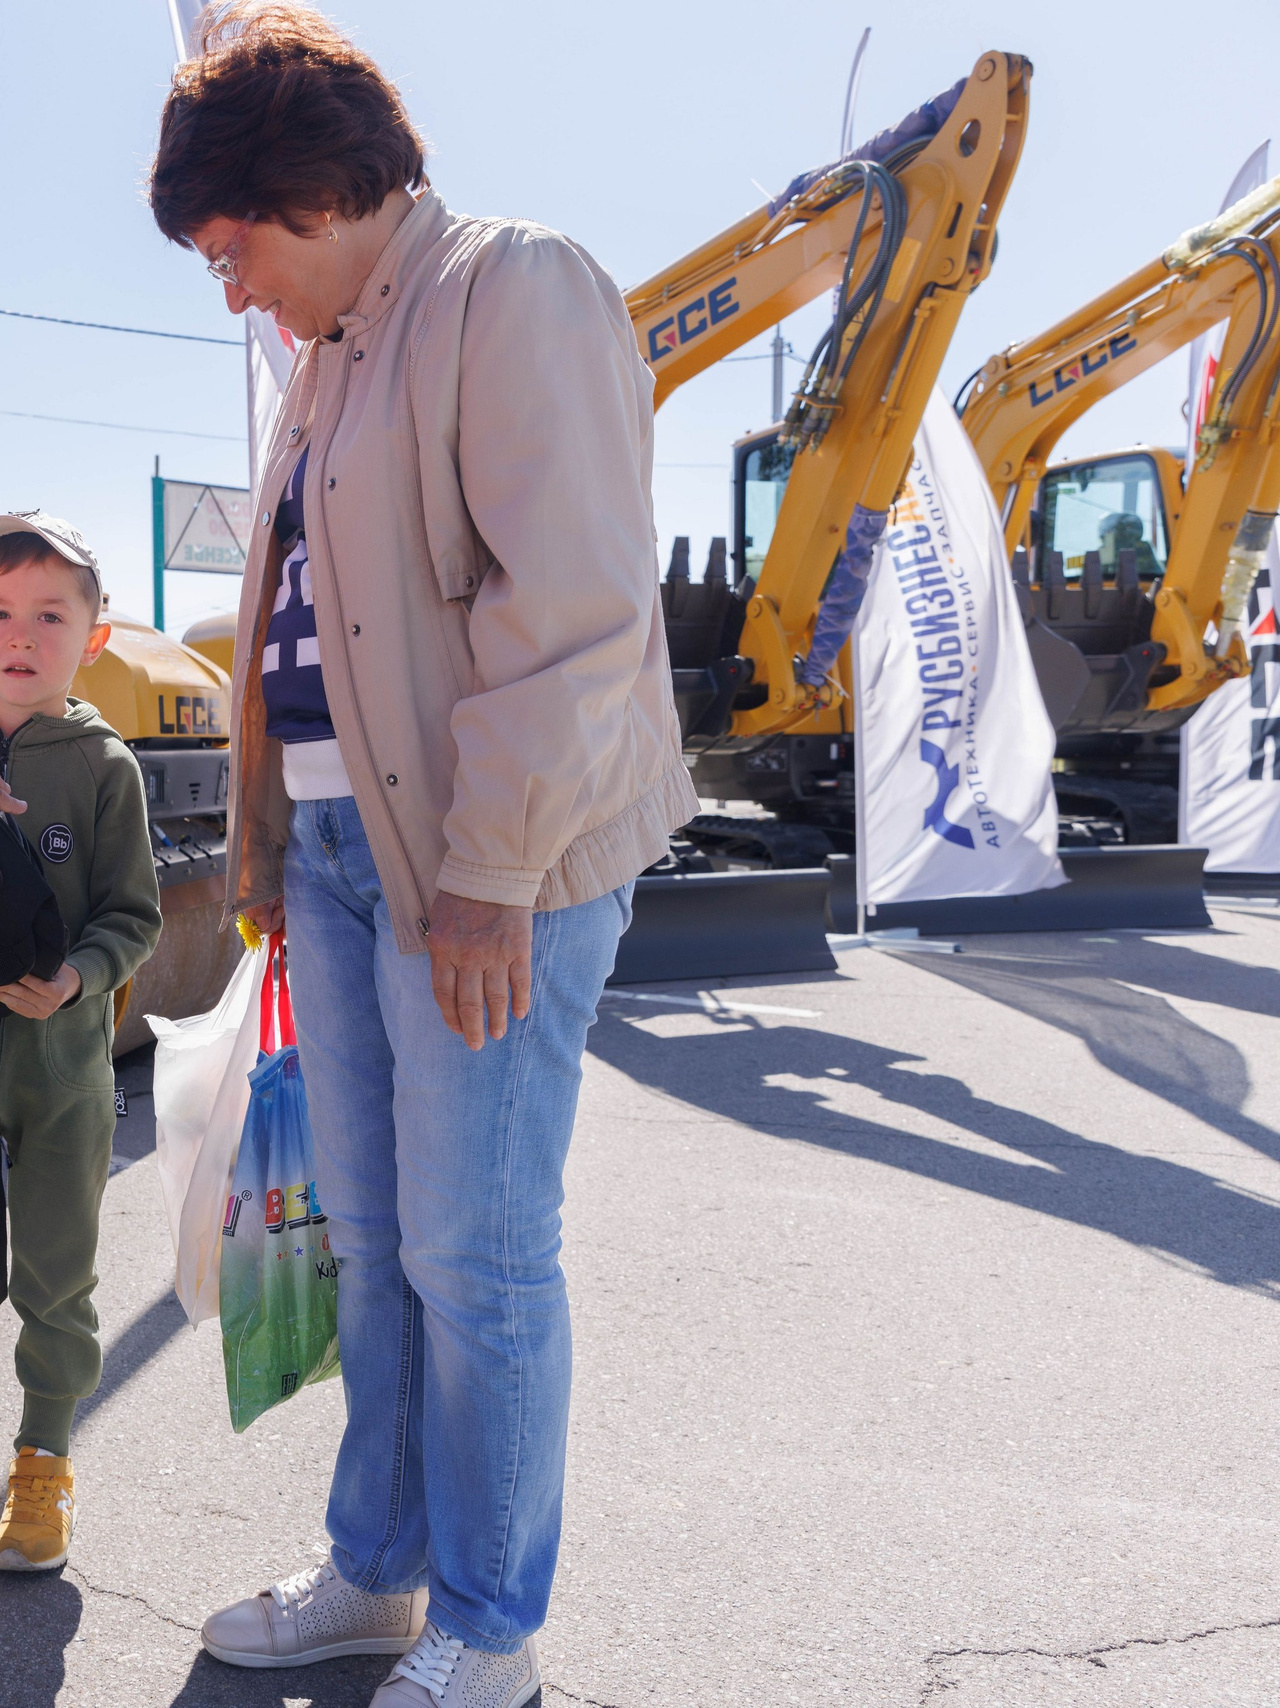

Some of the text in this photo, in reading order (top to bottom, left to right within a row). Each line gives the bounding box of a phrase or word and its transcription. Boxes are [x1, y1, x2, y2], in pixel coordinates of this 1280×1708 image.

[644, 277, 739, 364] GCE
[911, 459, 1000, 849] АВТОТЕХНИКА СЕРВИС ЗАПЧАС
[158, 695, 221, 735] LGCE
[53, 837, 68, 849] Bb
[316, 1257, 339, 1280] Kid
